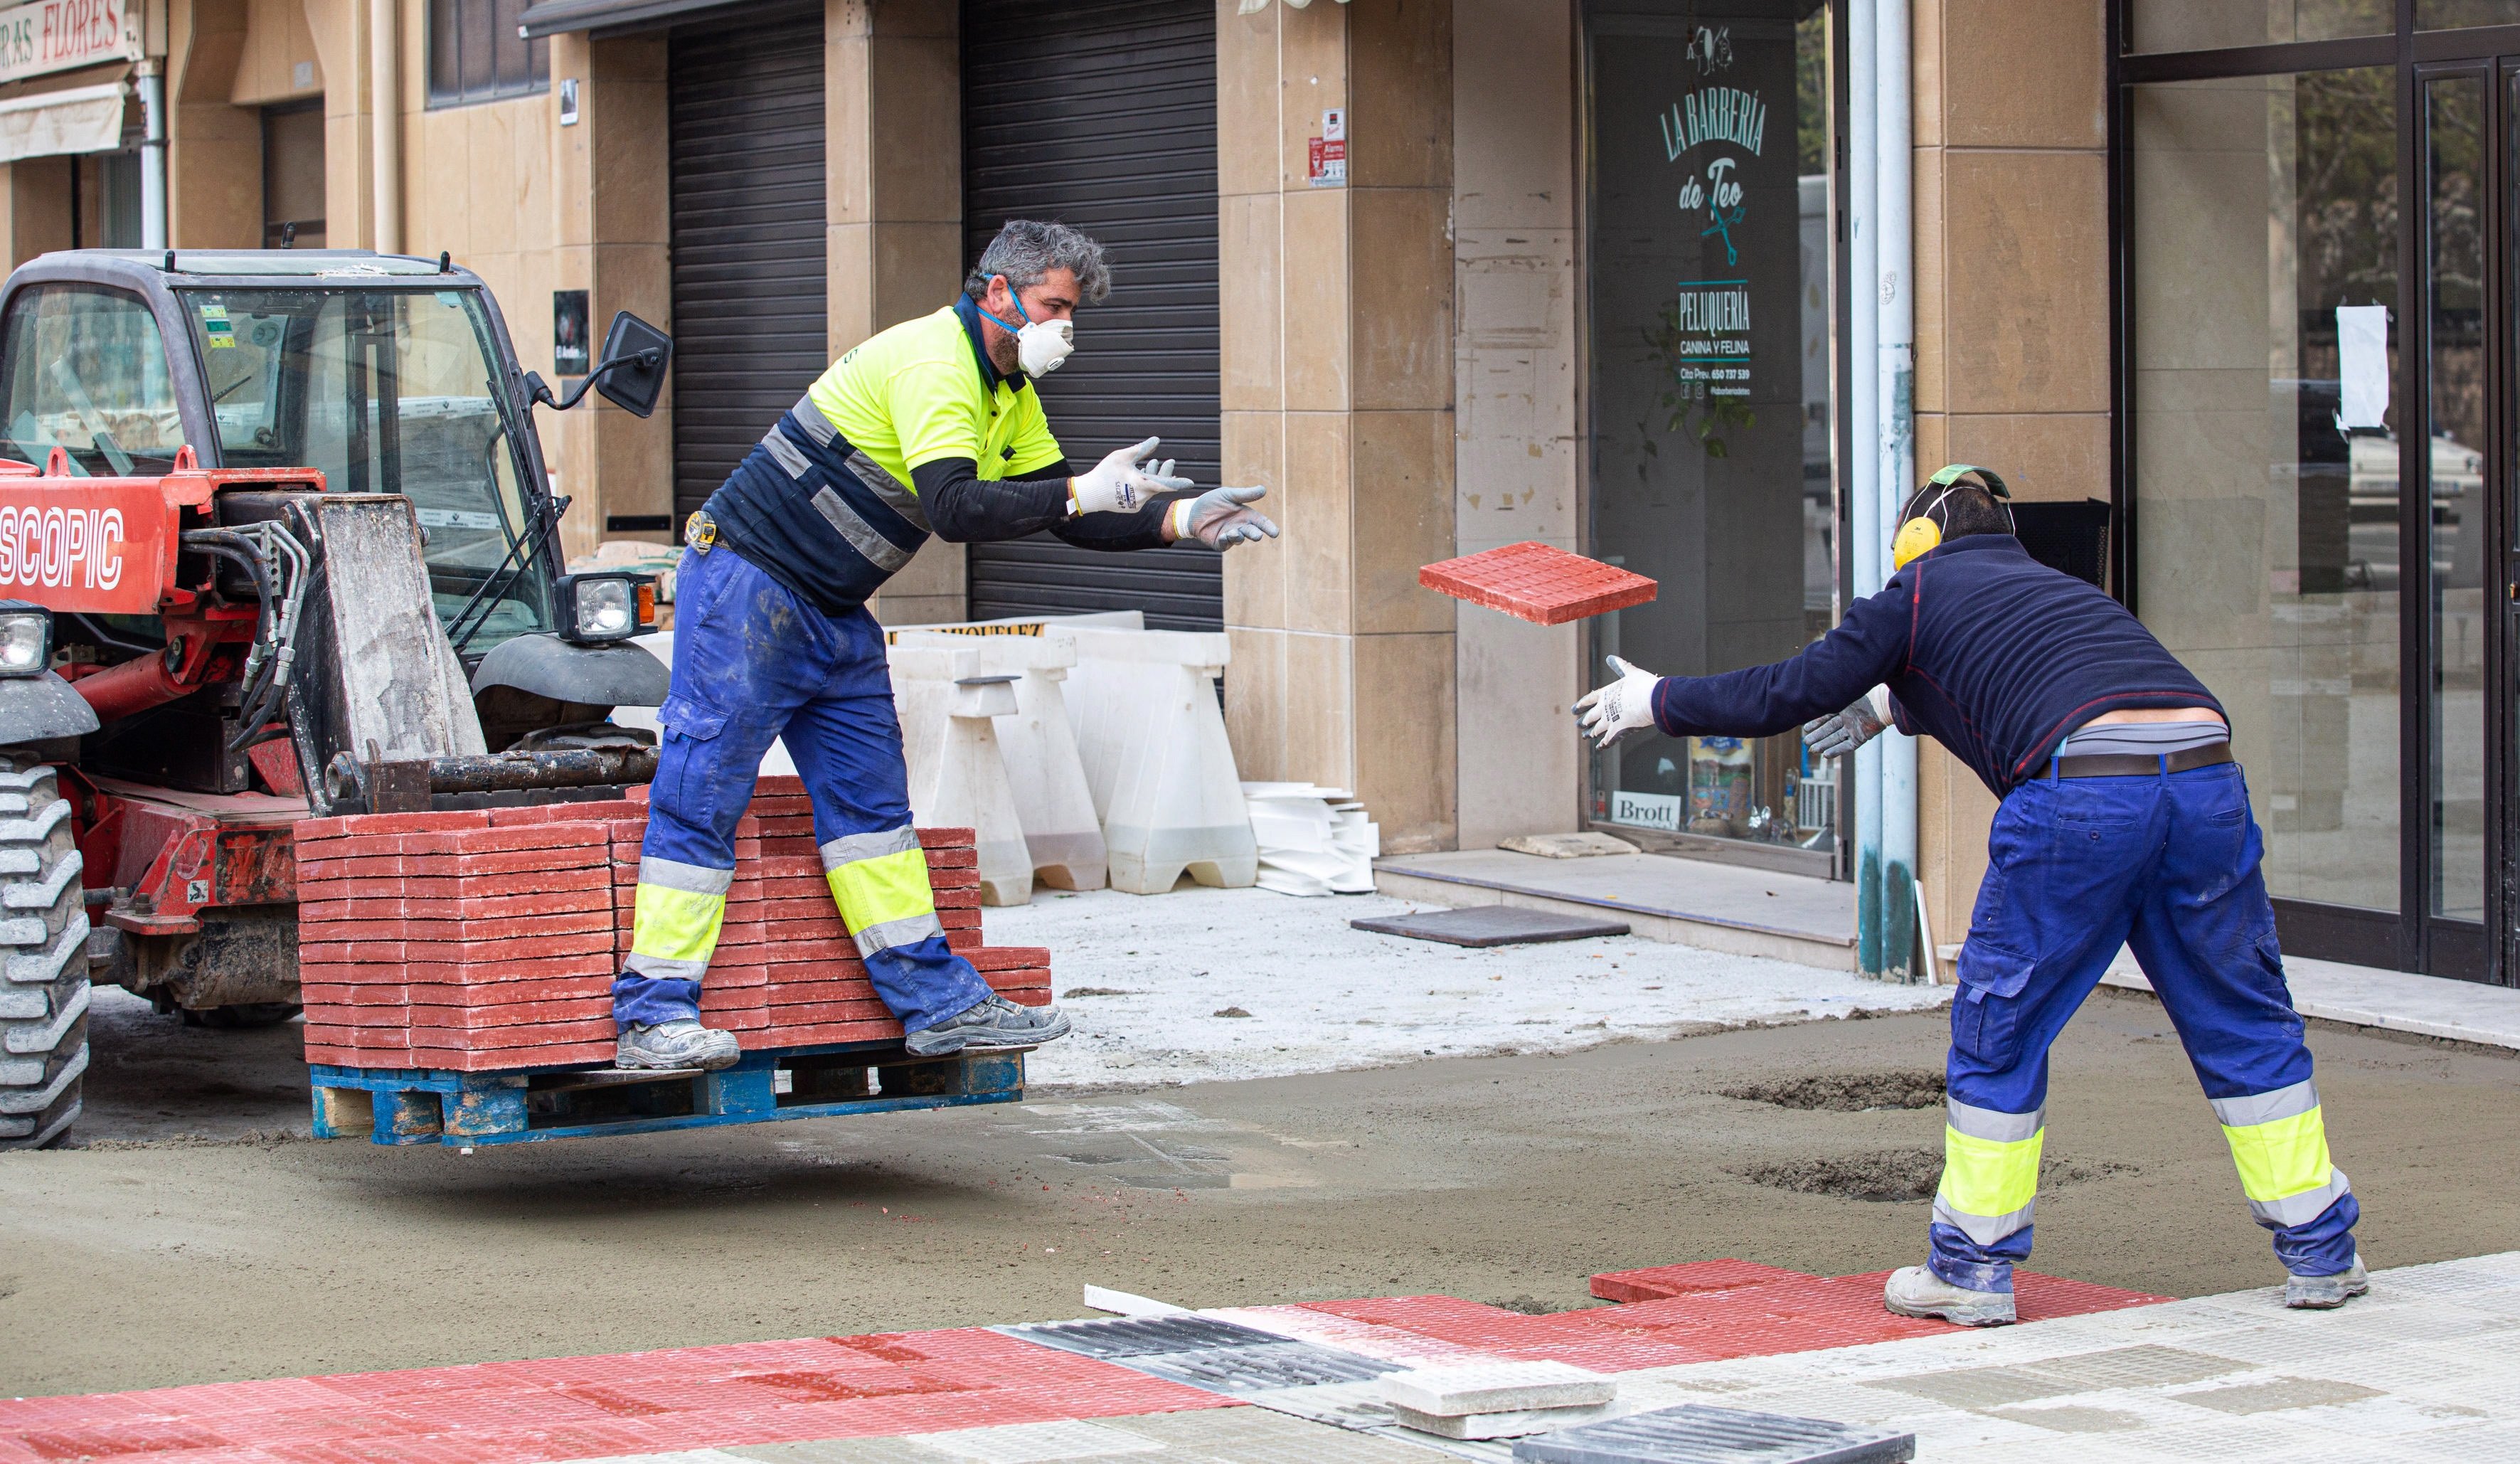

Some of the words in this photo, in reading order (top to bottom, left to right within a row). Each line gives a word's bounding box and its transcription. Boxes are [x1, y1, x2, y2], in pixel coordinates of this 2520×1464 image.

[0, 18, 33, 68] RAS
[43, 0, 117, 60] FLORES
[1660, 103, 1687, 162] LA
[1685, 87, 1766, 157] BARBERÍA
[1679, 175, 1705, 210] de
[1708, 157, 1743, 221] Teo
[1680, 285, 1750, 337] PELUQUERÍA
[1680, 340, 1711, 354] CANINA
[1713, 340, 1720, 354] Y
[1721, 339, 1750, 354] FELINA
[0, 506, 124, 590] SCOPIC
[942, 622, 1045, 637] QUELEZ
[1619, 800, 1671, 822] Brott
